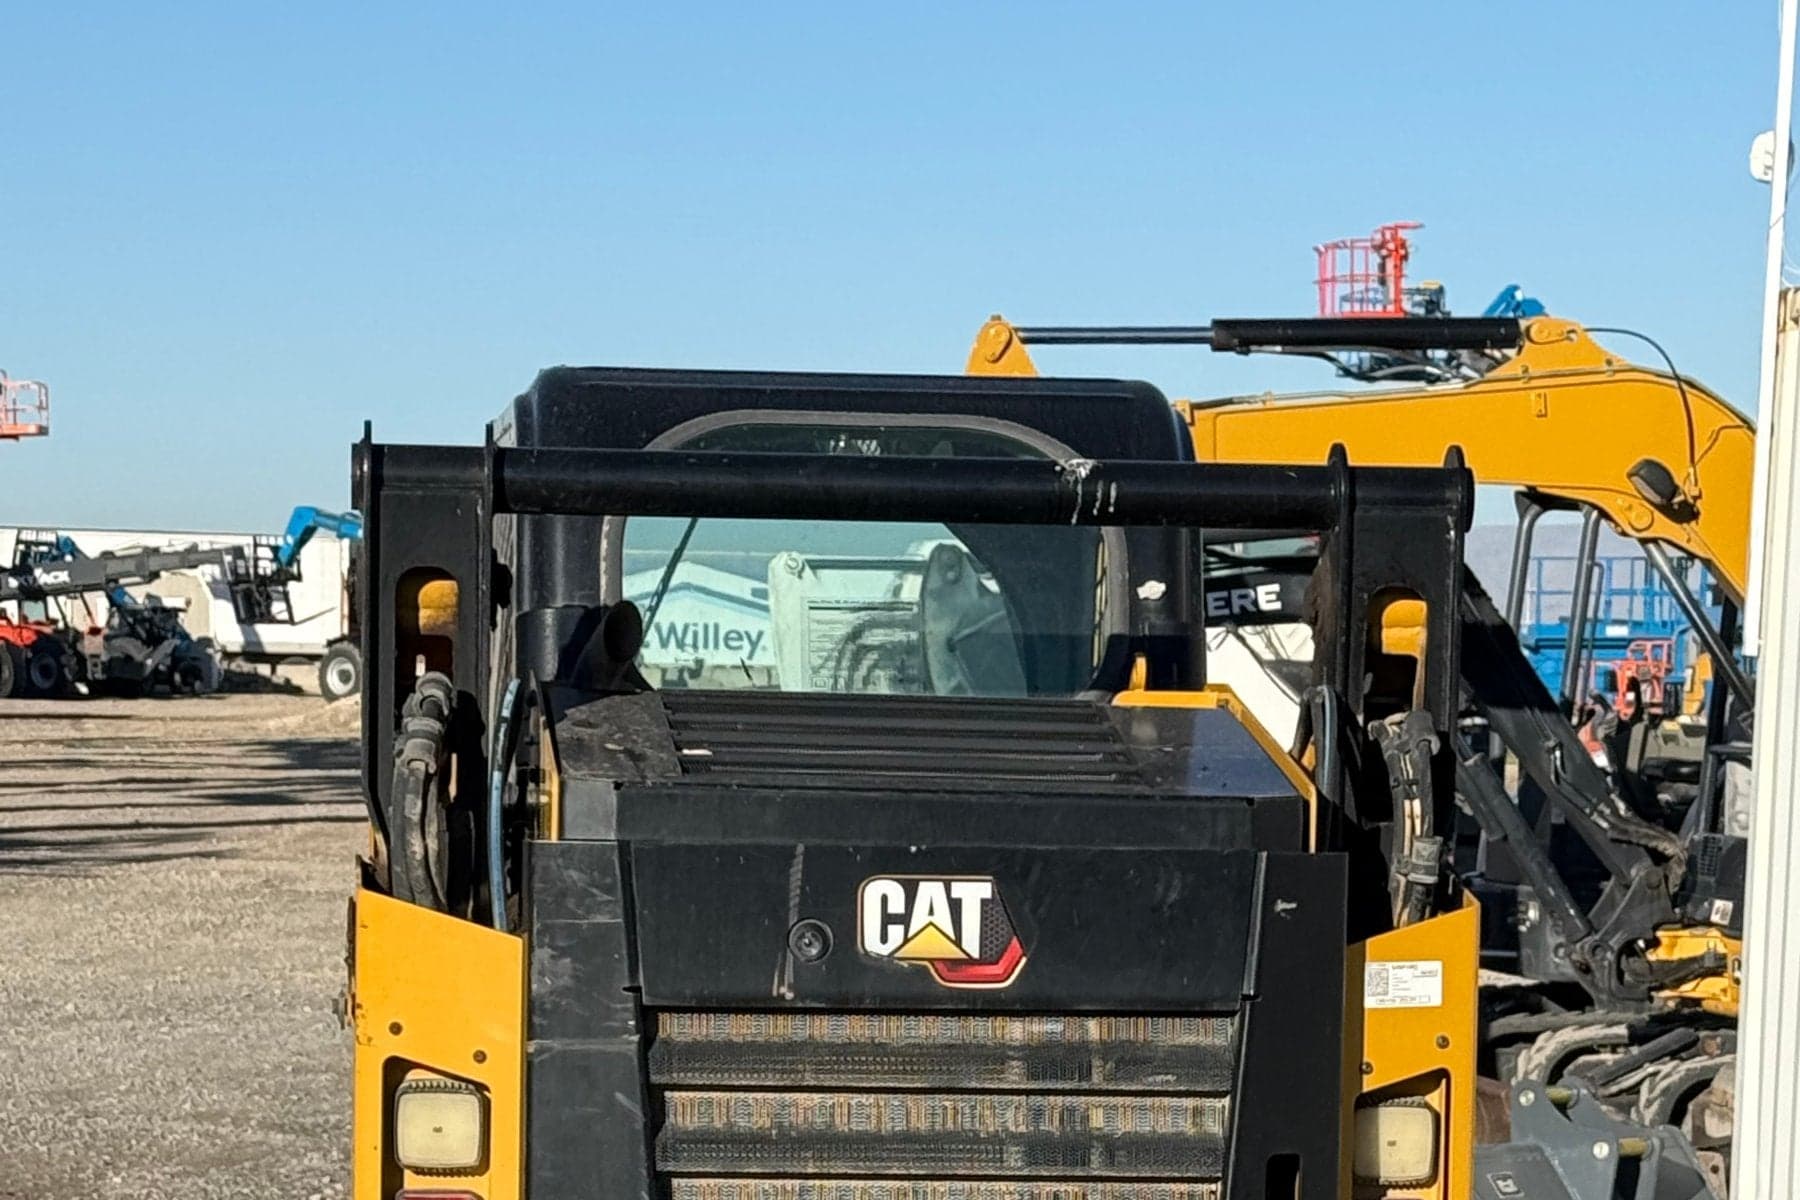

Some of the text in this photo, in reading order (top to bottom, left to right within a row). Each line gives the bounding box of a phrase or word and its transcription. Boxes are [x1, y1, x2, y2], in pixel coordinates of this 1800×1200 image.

[1205, 583, 1282, 617] ERE
[654, 621, 764, 660] Willey
[863, 879, 992, 959] CAT
